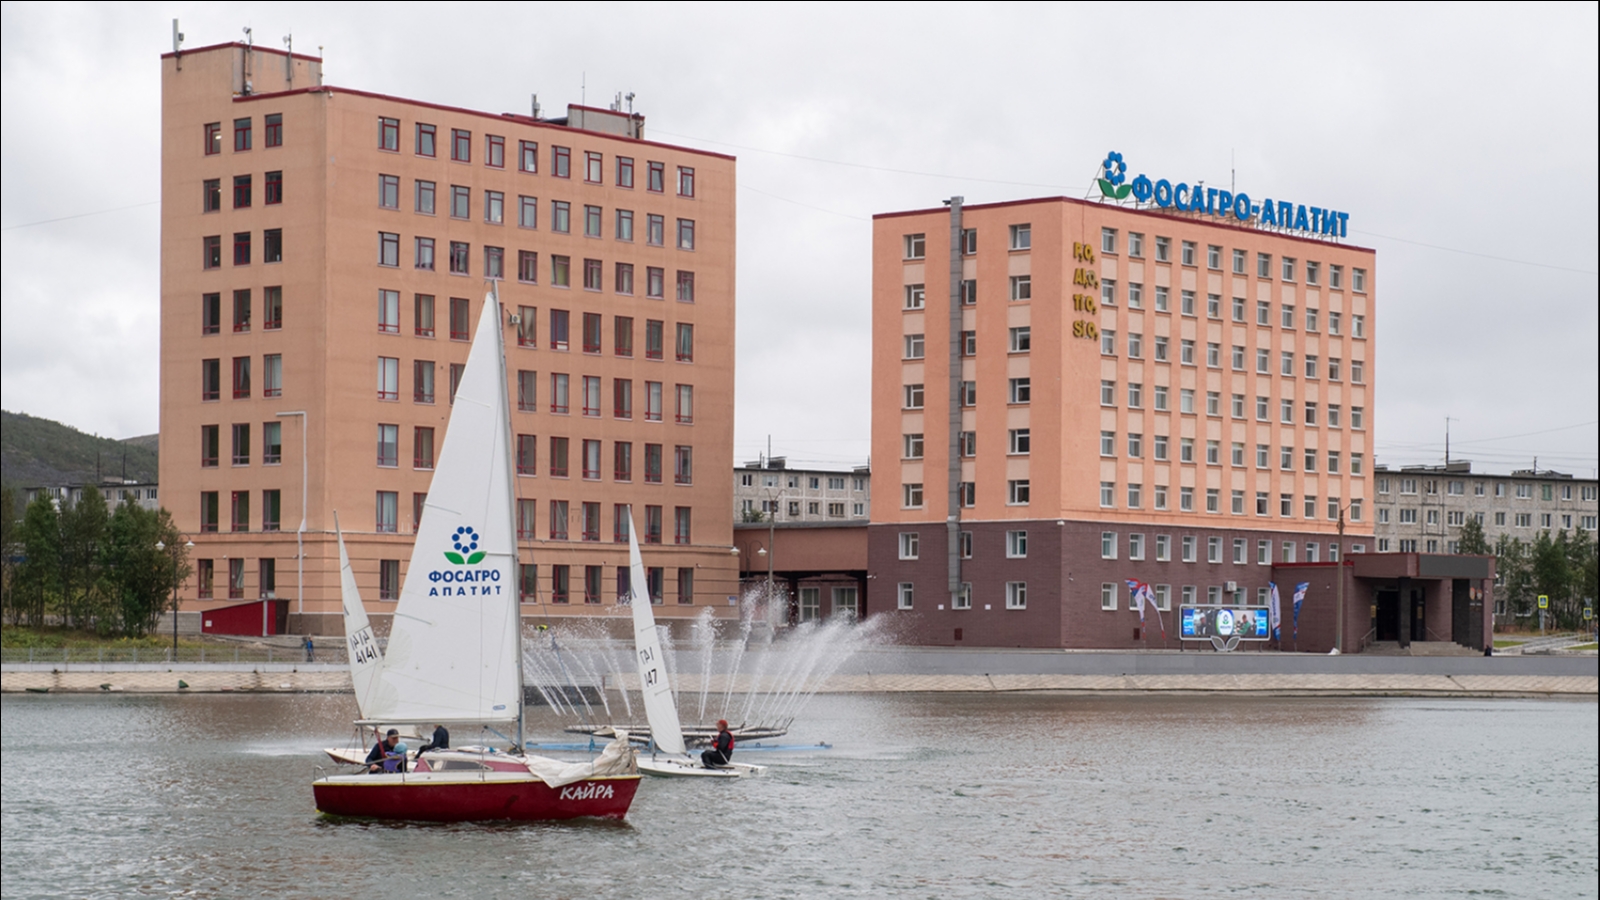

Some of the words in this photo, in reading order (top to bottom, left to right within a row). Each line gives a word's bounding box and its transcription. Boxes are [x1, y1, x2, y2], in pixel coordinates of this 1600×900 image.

[1131, 174, 1349, 237] ФОСАГРО-АПАТИТ
[428, 569, 501, 583] ФОСАГРО
[429, 585, 502, 597] АПАТИТ
[559, 782, 615, 800] КАЙРА
